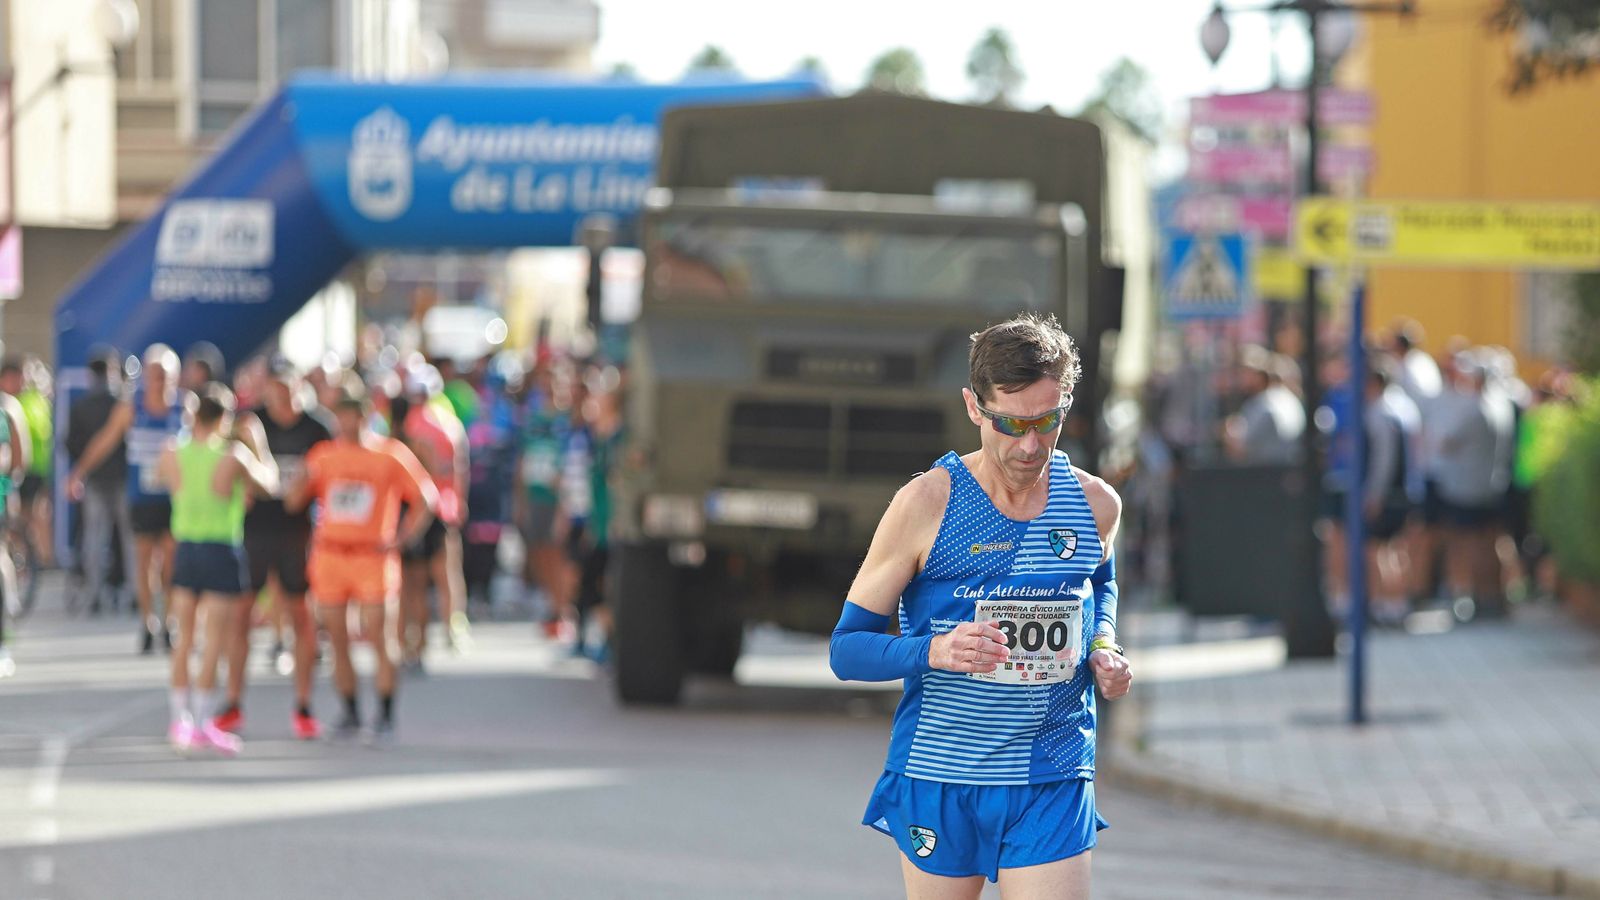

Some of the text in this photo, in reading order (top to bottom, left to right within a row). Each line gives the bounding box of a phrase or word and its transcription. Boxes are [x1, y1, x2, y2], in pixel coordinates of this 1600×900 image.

[416, 115, 657, 171] Ayuntamie
[452, 164, 507, 213] de
[513, 165, 566, 213] La
[983, 543, 1012, 551] INVERSE
[953, 584, 984, 598] Club
[986, 583, 1055, 600] Atletismo
